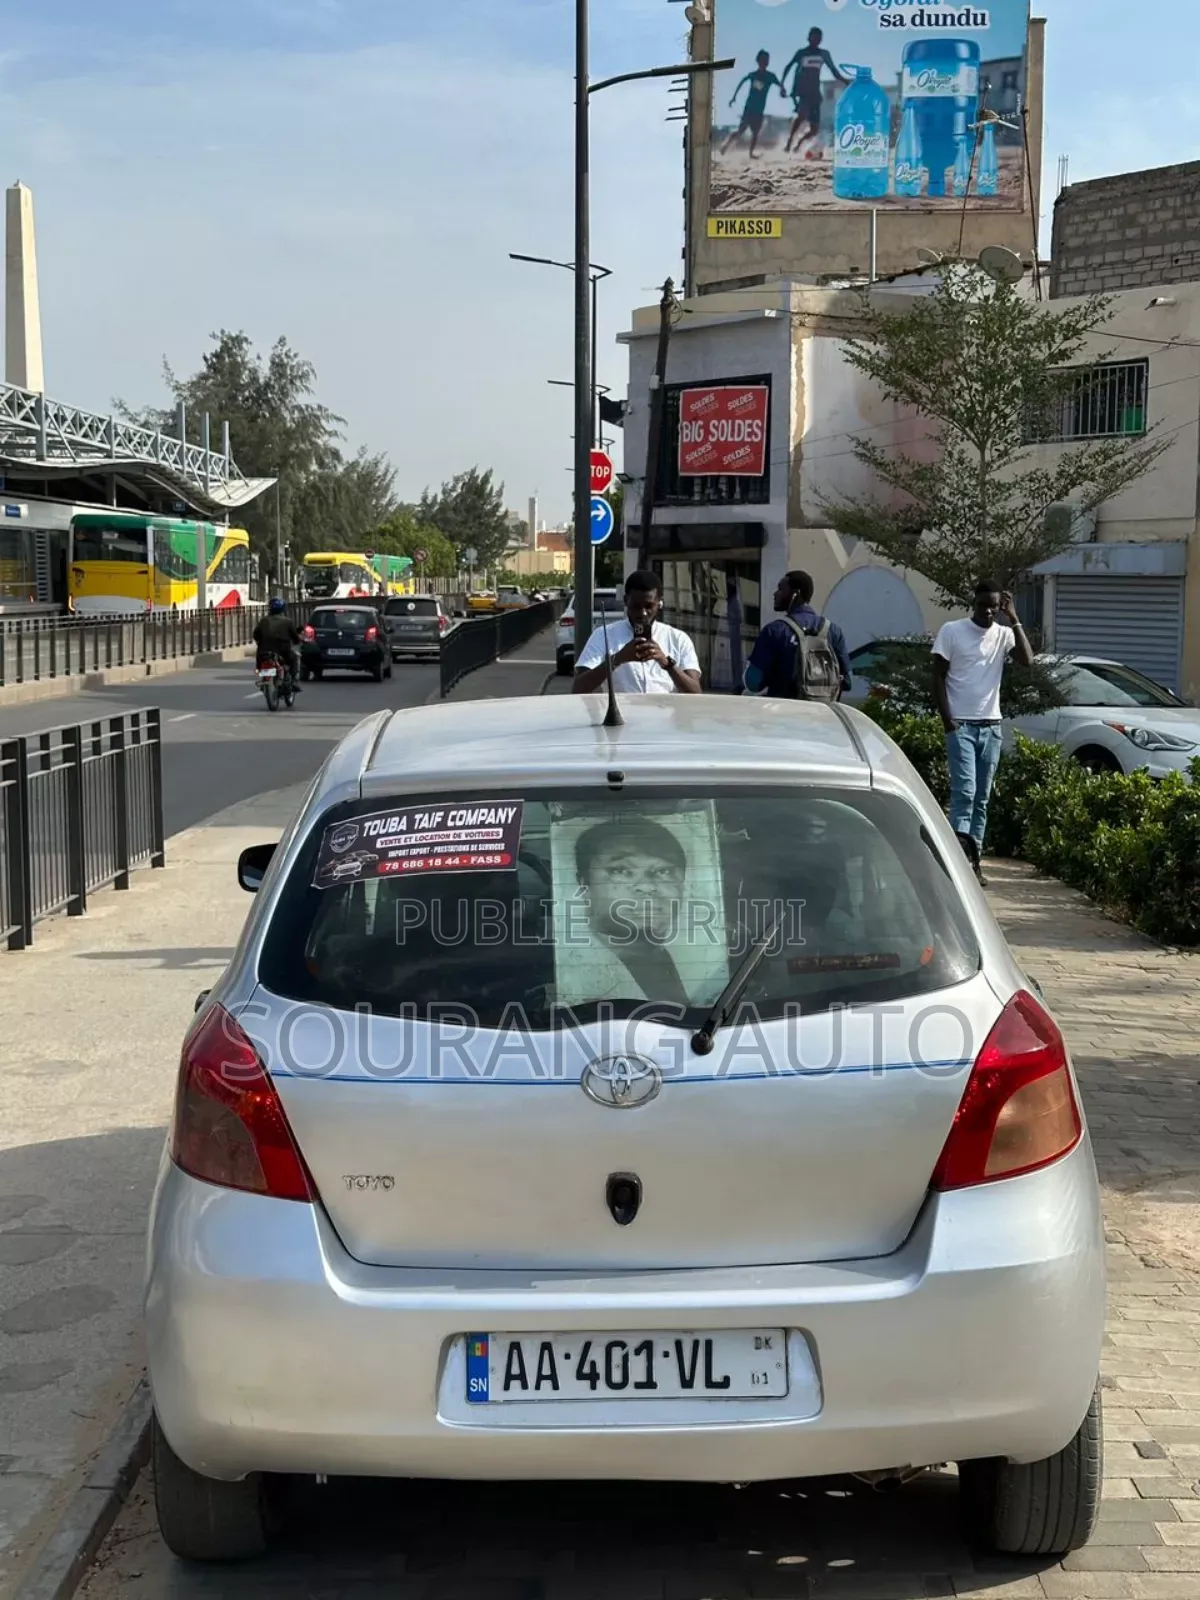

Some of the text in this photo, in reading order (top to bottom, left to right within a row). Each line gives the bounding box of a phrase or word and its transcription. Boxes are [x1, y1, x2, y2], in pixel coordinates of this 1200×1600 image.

[880, 9, 987, 27] sa dundu
[716, 219, 772, 235] PIKASSO
[690, 393, 715, 412] SOLDES
[728, 392, 753, 411] SOLDES
[682, 420, 761, 442] BIG SOLDES
[686, 442, 712, 463] SOLDES
[723, 445, 751, 465] SOLDES
[590, 465, 610, 478] TOP
[363, 807, 517, 837] TOUBA TAIF COMPANY
[380, 830, 500, 846] VENTE ET LOCATION DE VOITURES
[385, 862, 399, 871] 78
[428, 858, 441, 867] 18
[445, 857, 459, 865] 44
[470, 855, 501, 864] FASS
[342, 1174, 395, 1191] TOYO
[470, 1378, 487, 1392] SN
